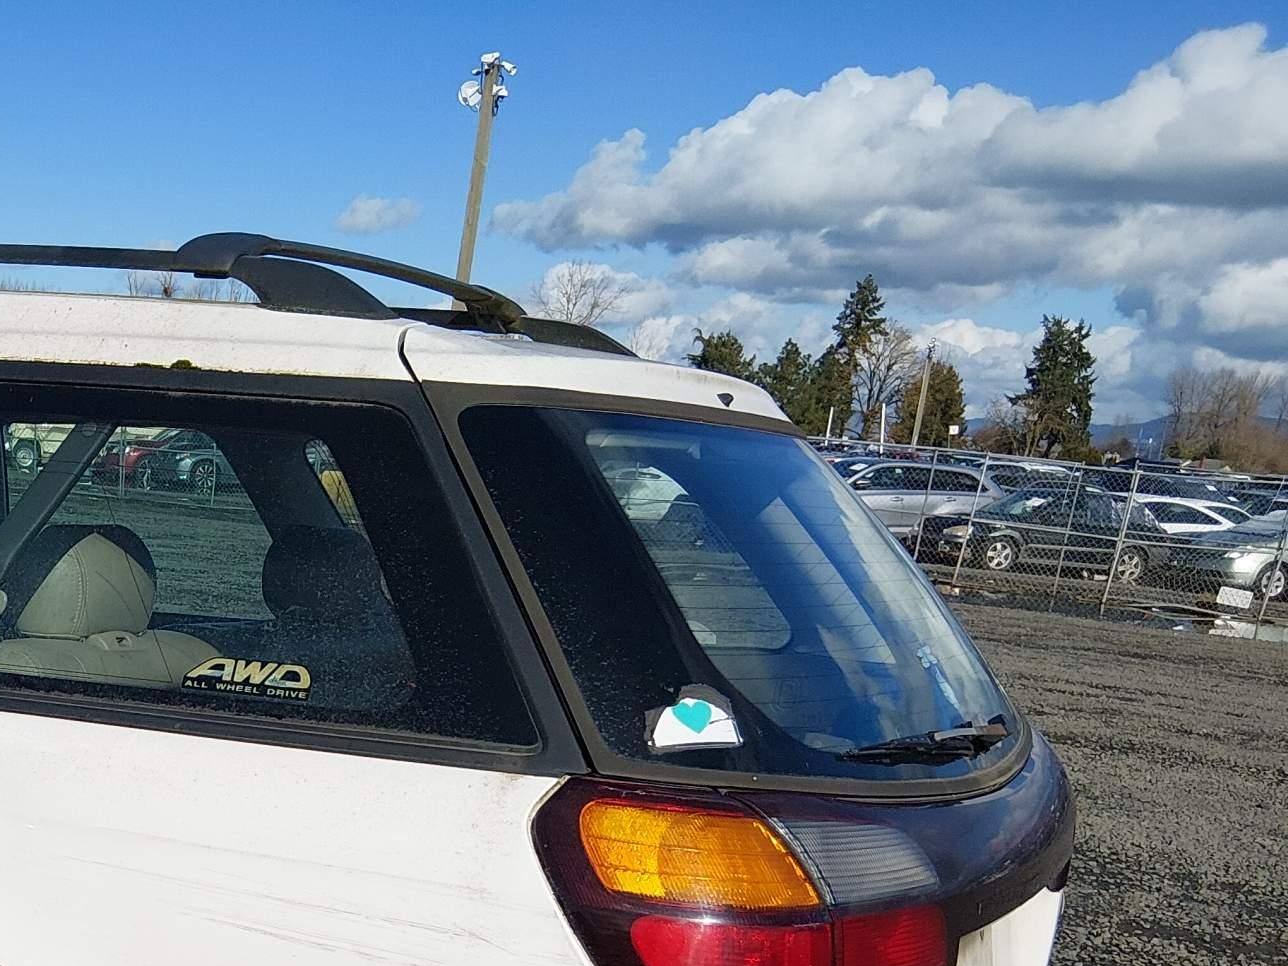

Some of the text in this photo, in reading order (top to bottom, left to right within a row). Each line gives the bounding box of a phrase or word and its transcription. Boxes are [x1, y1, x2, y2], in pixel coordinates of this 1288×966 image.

[186, 658, 311, 688] AWD
[184, 680, 308, 699] ALL WHEEL DRIVE
